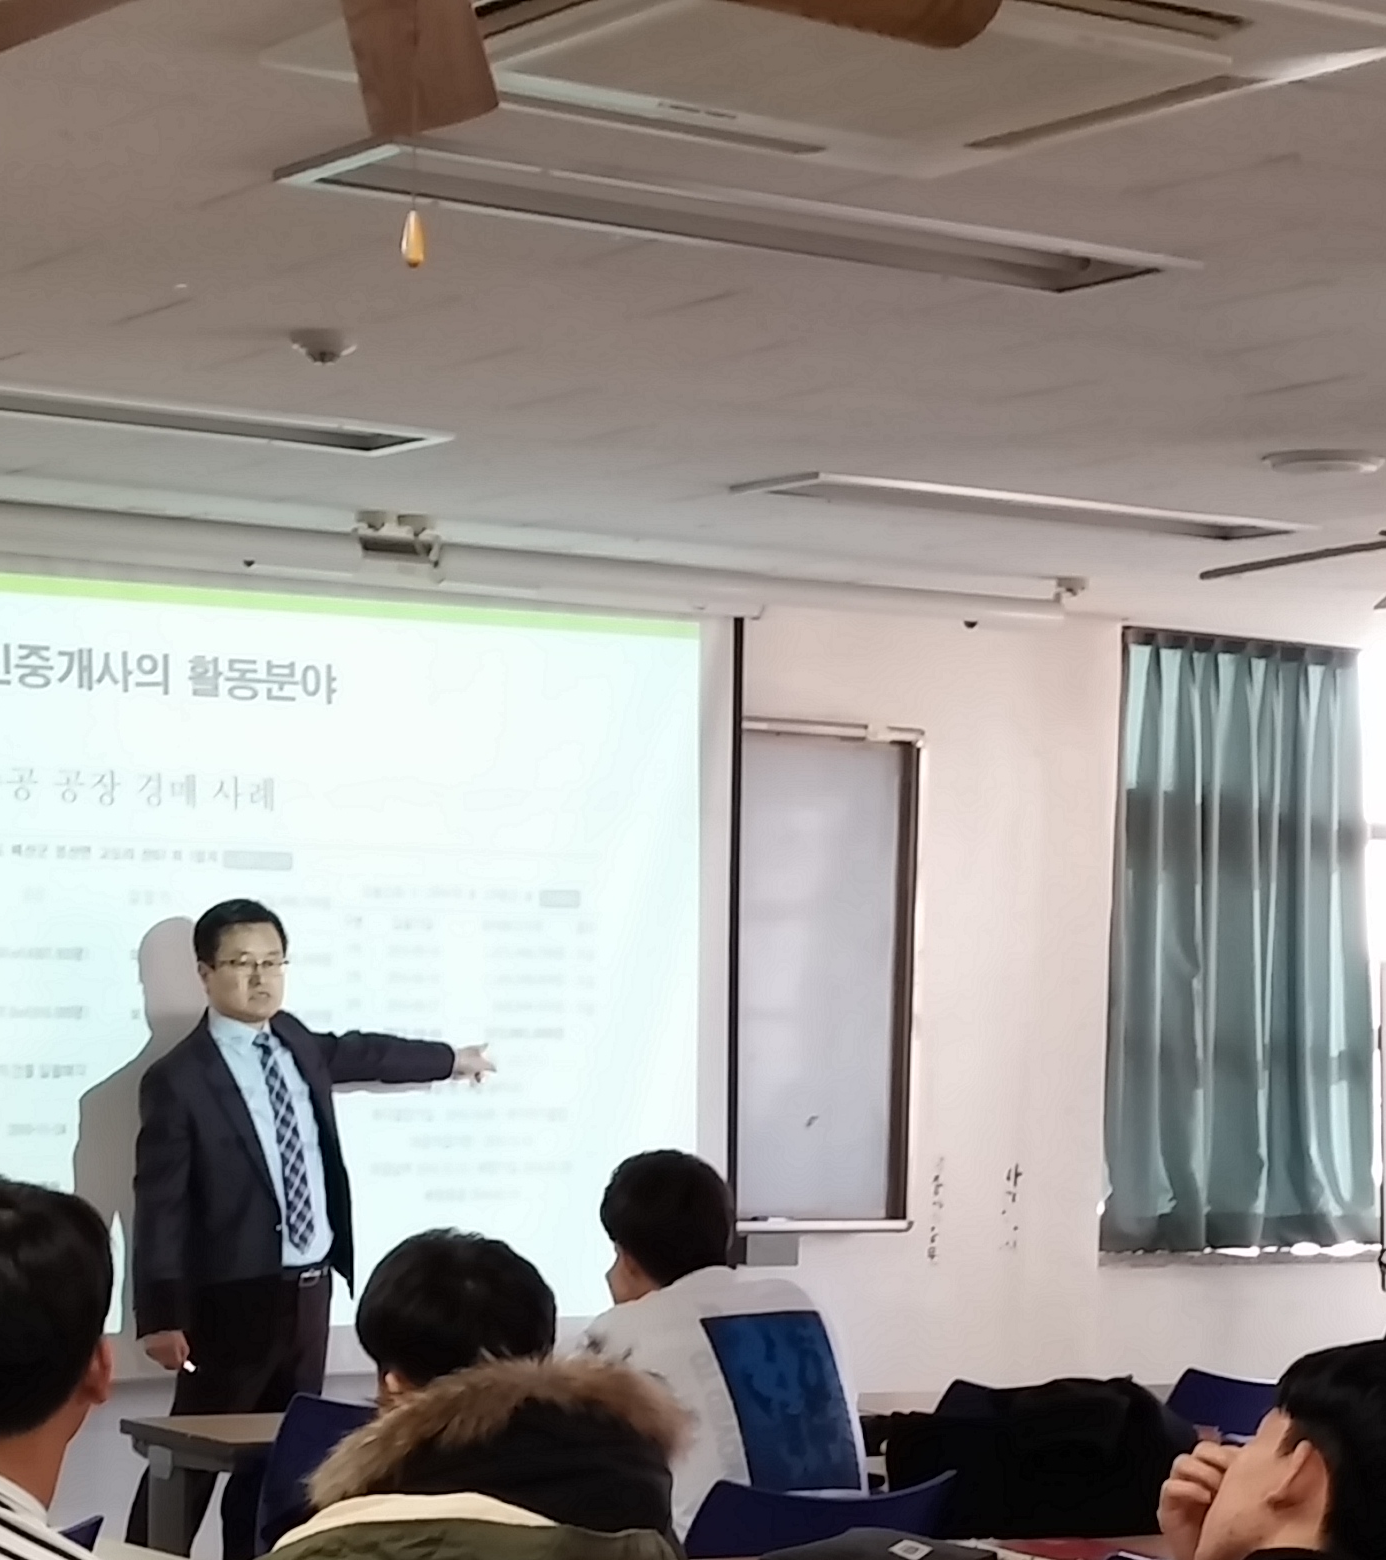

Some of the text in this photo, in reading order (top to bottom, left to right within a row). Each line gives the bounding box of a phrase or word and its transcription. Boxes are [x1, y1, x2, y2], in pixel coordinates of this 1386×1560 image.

[187, 655, 338, 706] 활동분야
[54, 769, 121, 807] 공장
[137, 772, 197, 809] 경매
[212, 775, 275, 812] 사례
